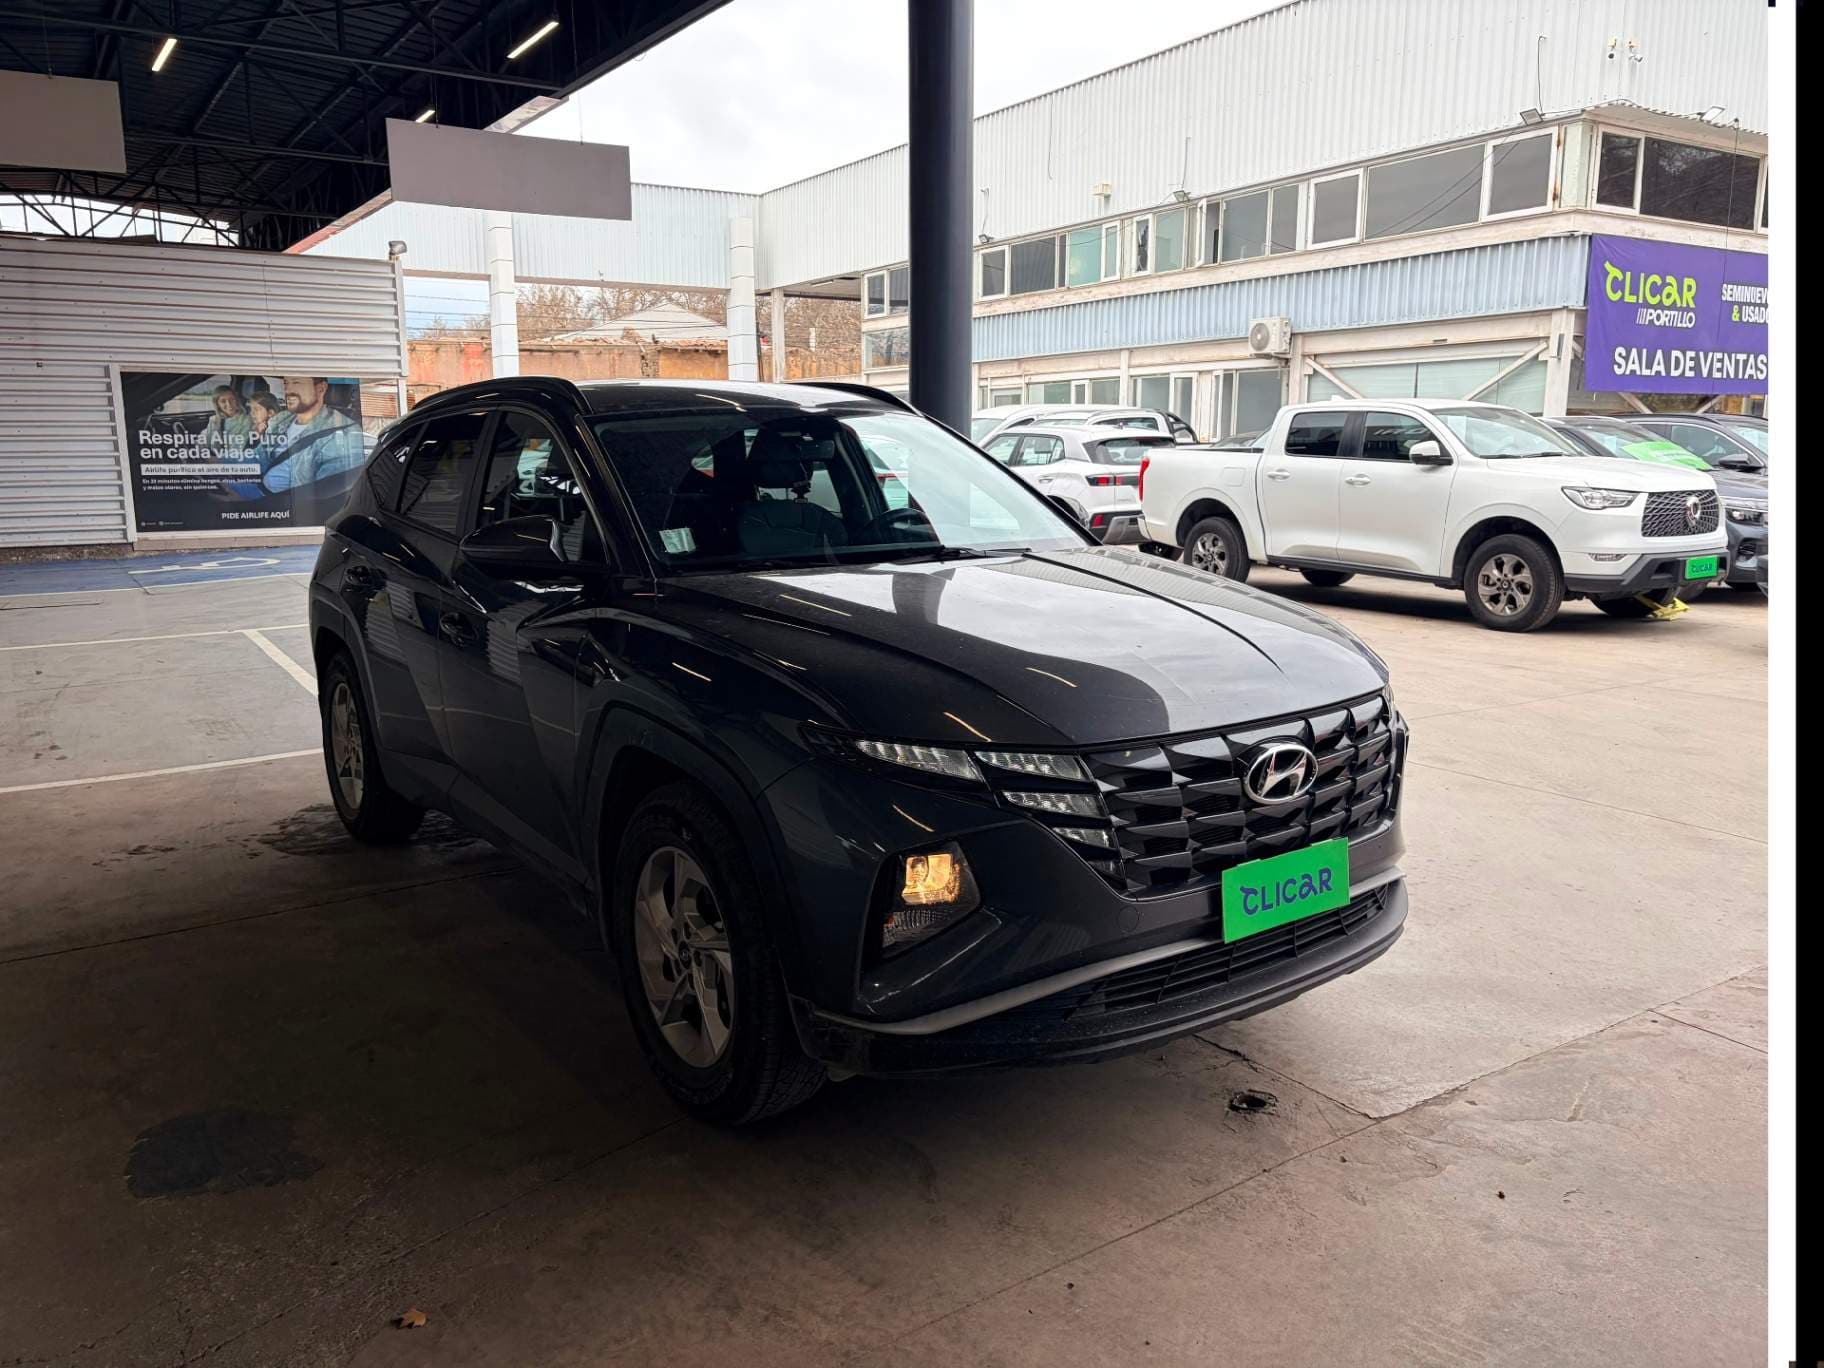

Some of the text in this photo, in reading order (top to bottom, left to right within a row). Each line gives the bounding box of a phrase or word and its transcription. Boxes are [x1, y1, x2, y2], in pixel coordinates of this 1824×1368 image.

[1721, 284, 1768, 304] SEMINUEV
[1732, 304, 1740, 322] &
[1613, 347, 1768, 380] SALA DE VENTAS
[139, 430, 288, 447] Respira Aire Puro
[139, 445, 260, 461] en cada viaje.
[240, 511, 270, 519] AIRLIFE
